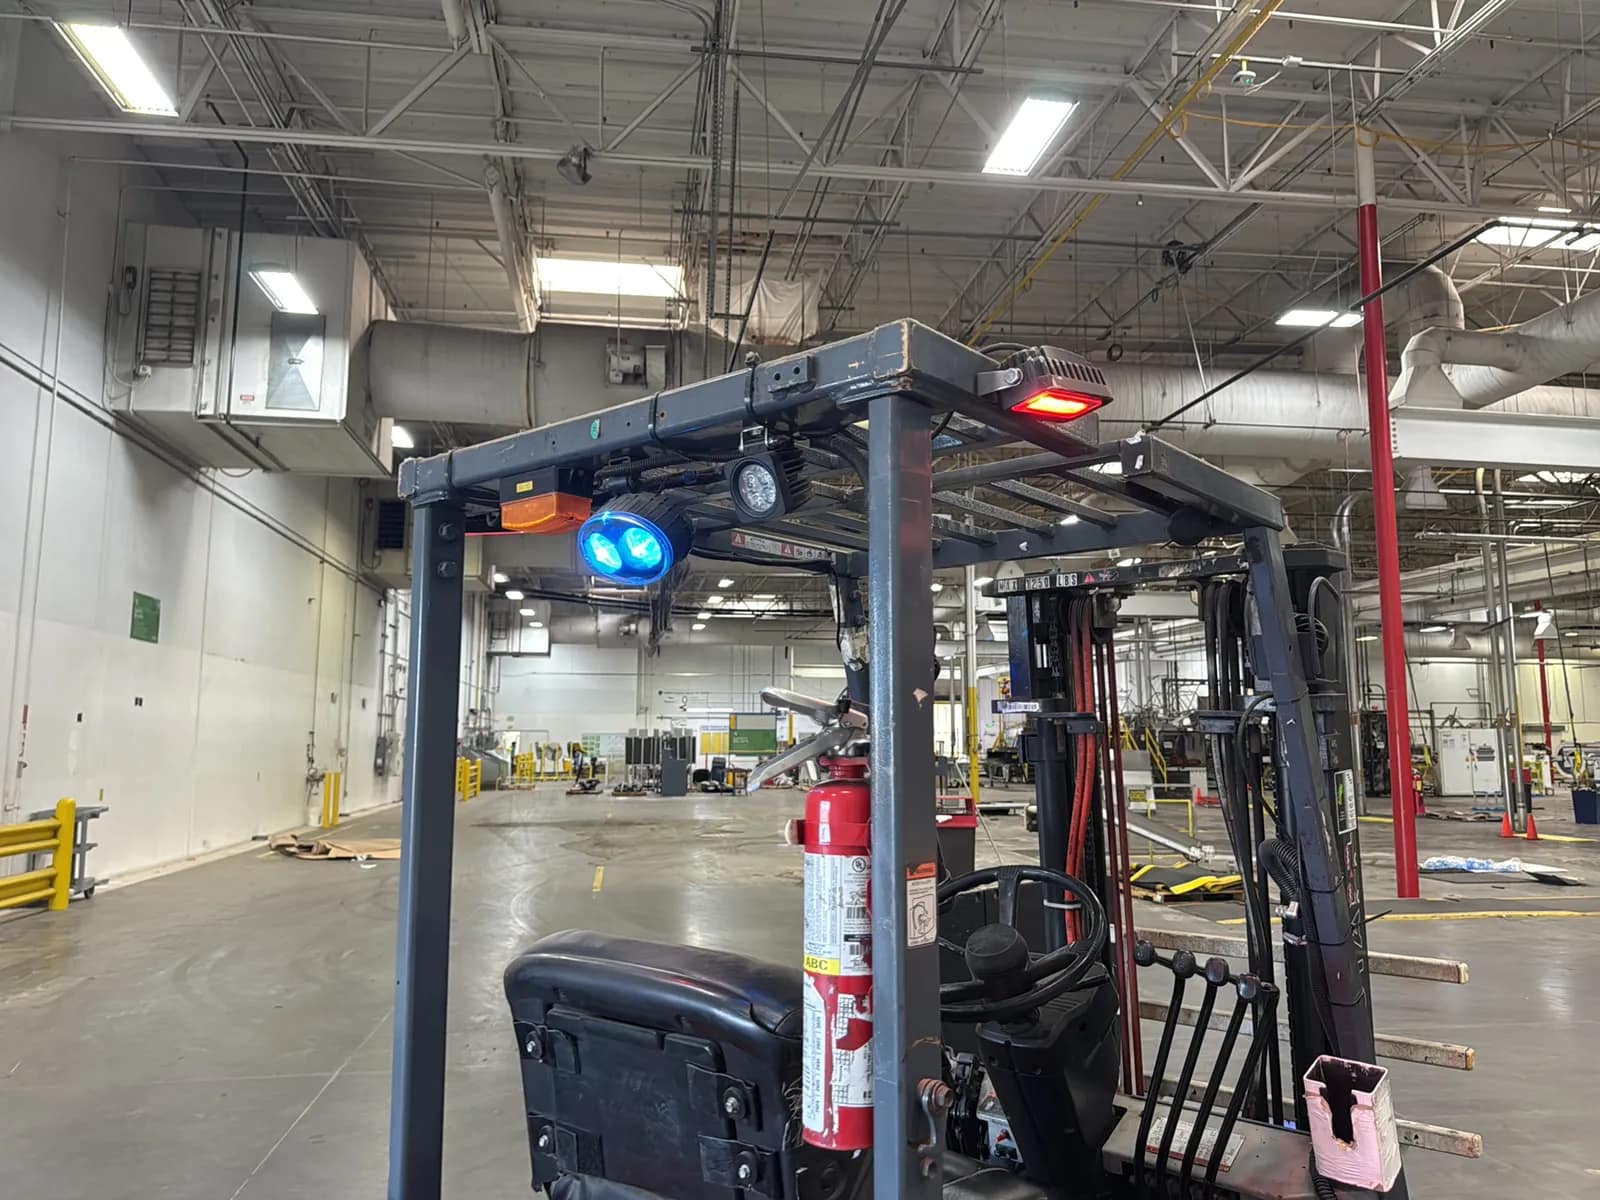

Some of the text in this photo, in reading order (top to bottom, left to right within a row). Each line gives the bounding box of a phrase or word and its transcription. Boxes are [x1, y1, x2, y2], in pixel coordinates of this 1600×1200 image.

[1025, 576, 1050, 590] 1250
[1057, 574, 1077, 586] LBS
[806, 956, 829, 970] ABC
